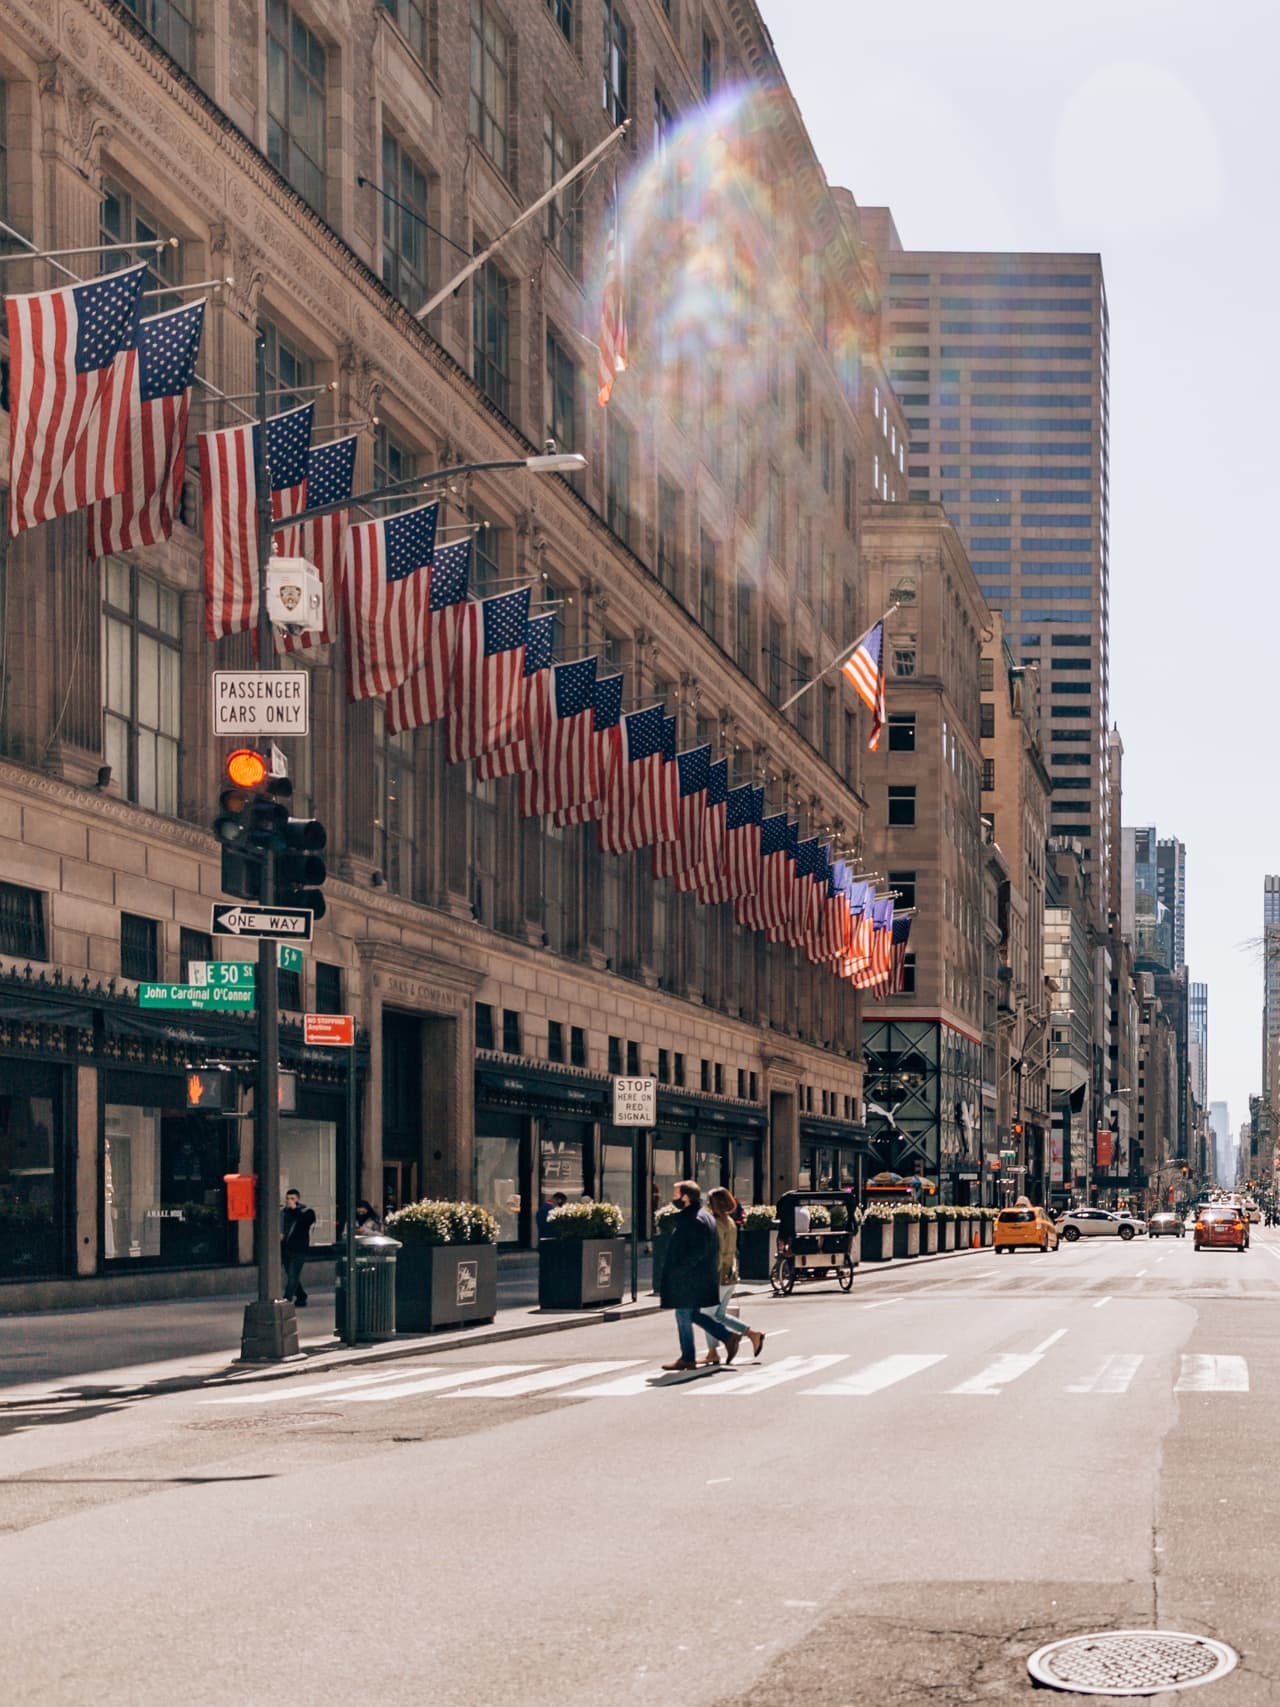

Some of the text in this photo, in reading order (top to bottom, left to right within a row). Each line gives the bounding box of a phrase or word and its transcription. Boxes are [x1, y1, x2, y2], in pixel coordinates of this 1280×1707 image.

[220, 682, 301, 698] PASSENGER
[220, 706, 300, 722] CARS ONLY
[228, 915, 299, 930] ONE WAY
[284, 949, 290, 966] 5
[207, 965, 252, 984] E 50 St
[144, 986, 252, 1001] John Cardinal O'Connor
[192, 1001, 204, 1009] Way
[618, 1081, 652, 1092] STOP
[618, 1094, 652, 1102] HERE ON
[625, 1103, 643, 1111] RED
[618, 1113, 651, 1121] SIGNAL
